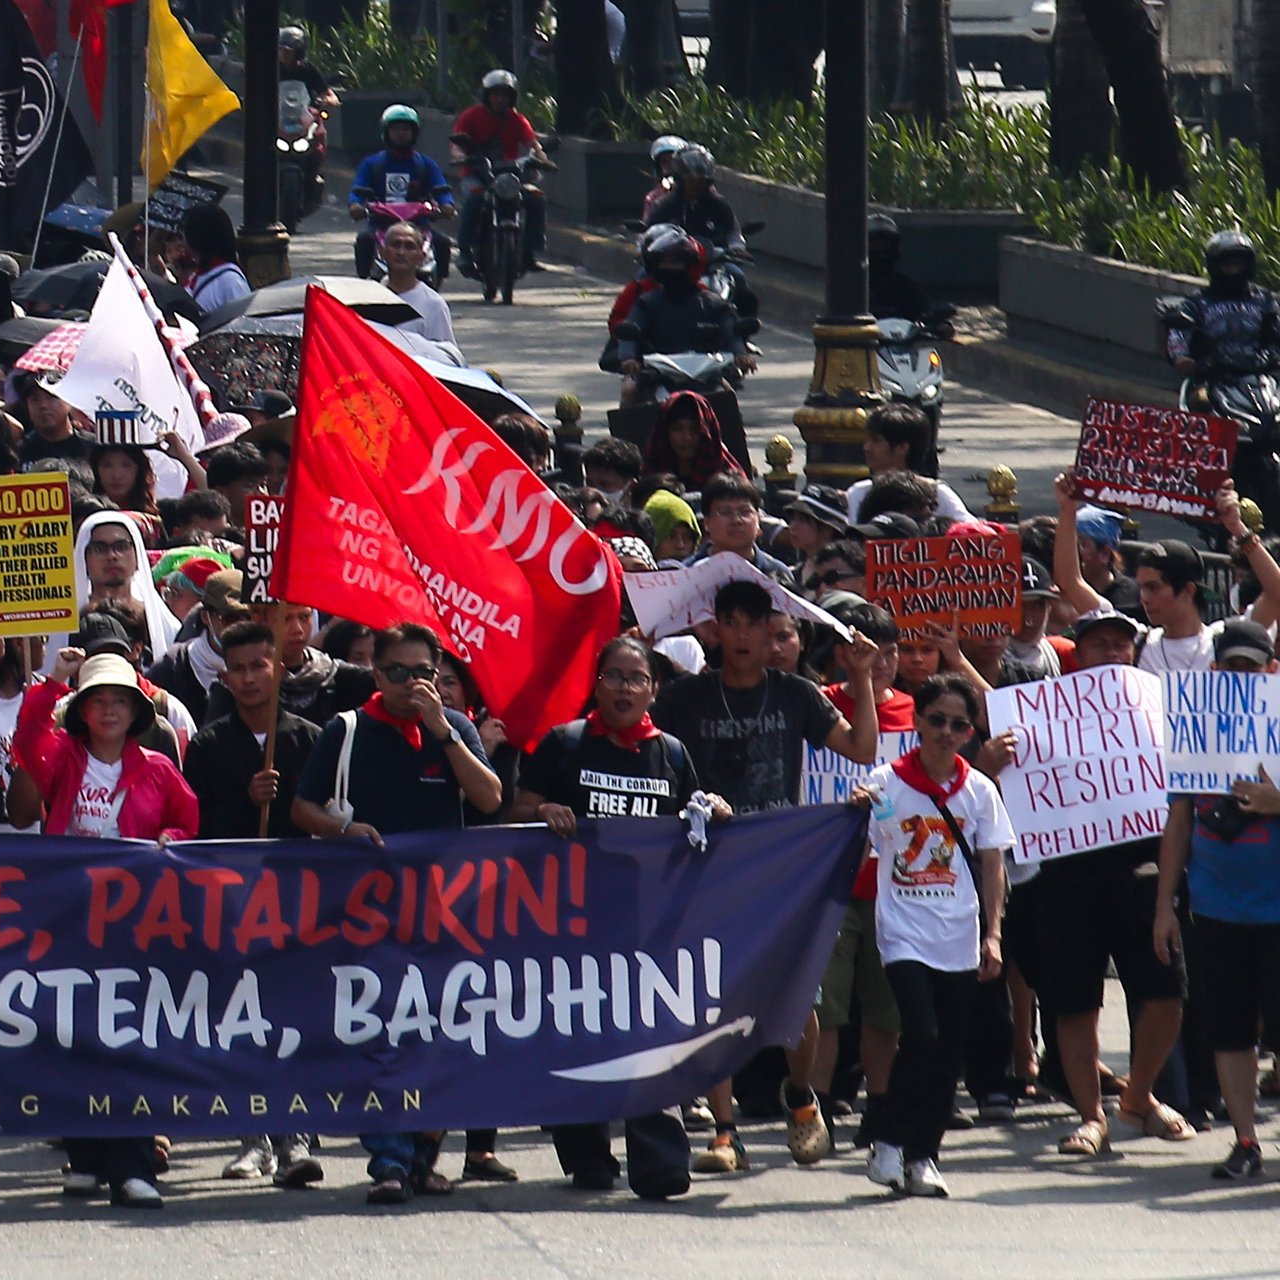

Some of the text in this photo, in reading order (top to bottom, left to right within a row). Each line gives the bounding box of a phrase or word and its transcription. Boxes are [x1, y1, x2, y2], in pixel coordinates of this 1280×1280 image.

[402, 427, 609, 596] KMU
[20, 520, 68, 542] SALARY
[12, 542, 58, 558] NURSES
[30, 556, 68, 572] ALLIED
[874, 536, 1006, 566] ITIGIL ANG
[2, 572, 47, 588] HEALTH
[339, 529, 486, 650] NG NA
[875, 562, 1020, 593] PANDARAHAS
[3, 612, 41, 621] WORKERS
[42, 610, 67, 619] UNITY
[903, 586, 1018, 617] KANAYUNAN
[1014, 667, 1162, 725] MARCOS
[1166, 671, 1267, 715] IKULONG
[1009, 708, 1164, 769] DUTERTE
[1167, 714, 1258, 755] YAN MGA
[581, 770, 669, 794] JAIL THE CORRUPT
[1024, 753, 1166, 813] RESIGN
[589, 790, 658, 818] FREE ALL
[1020, 806, 1170, 859] PCFLU-LAND
[85, 842, 588, 955] PATALSIKIN!
[331, 936, 725, 1057] BAGUHIN!
[88, 1088, 423, 1118] MAKABAYAN
